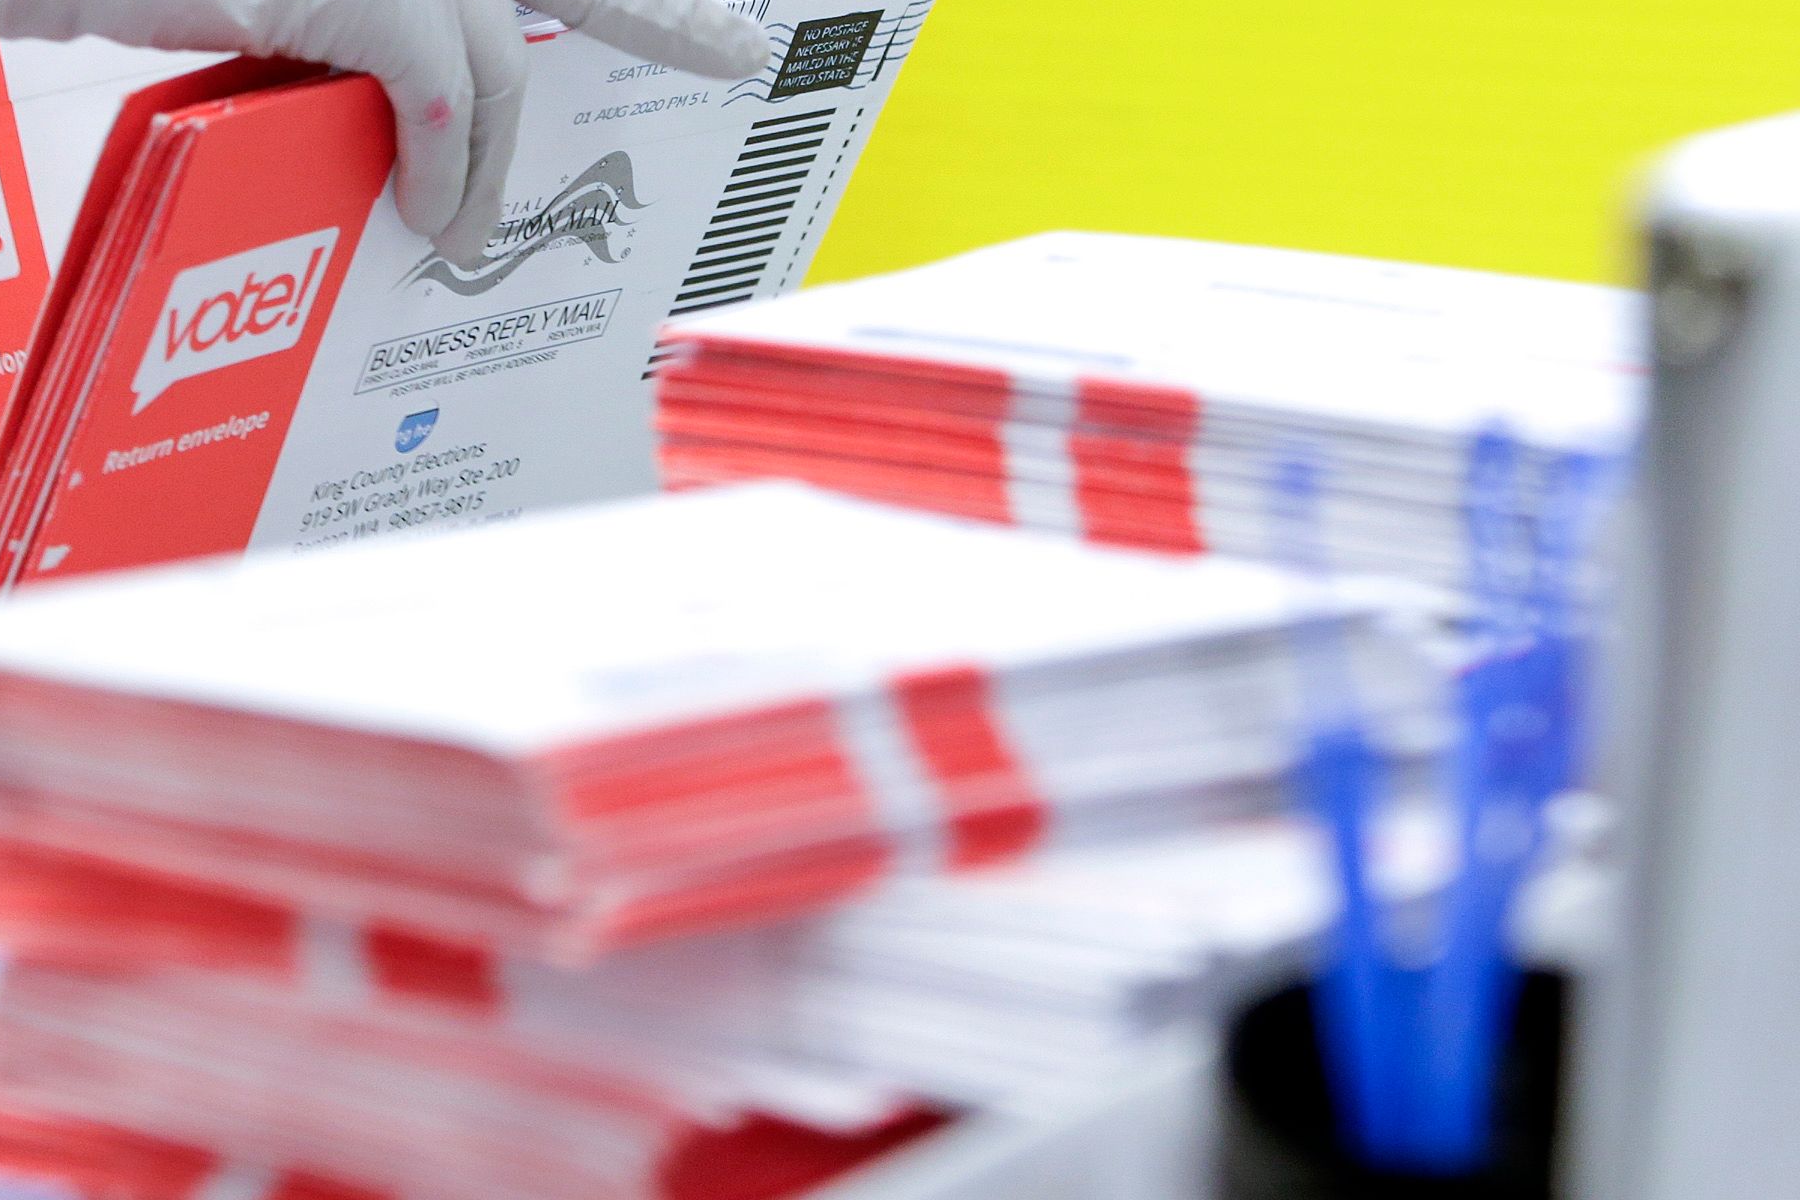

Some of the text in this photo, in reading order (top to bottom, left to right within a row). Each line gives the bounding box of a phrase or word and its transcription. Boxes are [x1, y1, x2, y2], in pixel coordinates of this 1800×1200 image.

[803, 20, 869, 41] NO POSTAGE
[786, 51, 860, 73] MAILED IN THE
[795, 41, 850, 58] NECESSARY
[778, 67, 853, 89] UNITED STATES
[593, 105, 629, 122] AUG
[629, 99, 665, 116] 2020
[667, 95, 690, 110] PM
[562, 199, 620, 233] MAIL
[165, 246, 325, 362] vote!
[369, 298, 606, 372] BUSINESS REPLY MAIL
[103, 411, 270, 475] Return envelope
[310, 442, 488, 504] King County Elections
[300, 457, 521, 532] 919 SW Grady Way Ste 200
